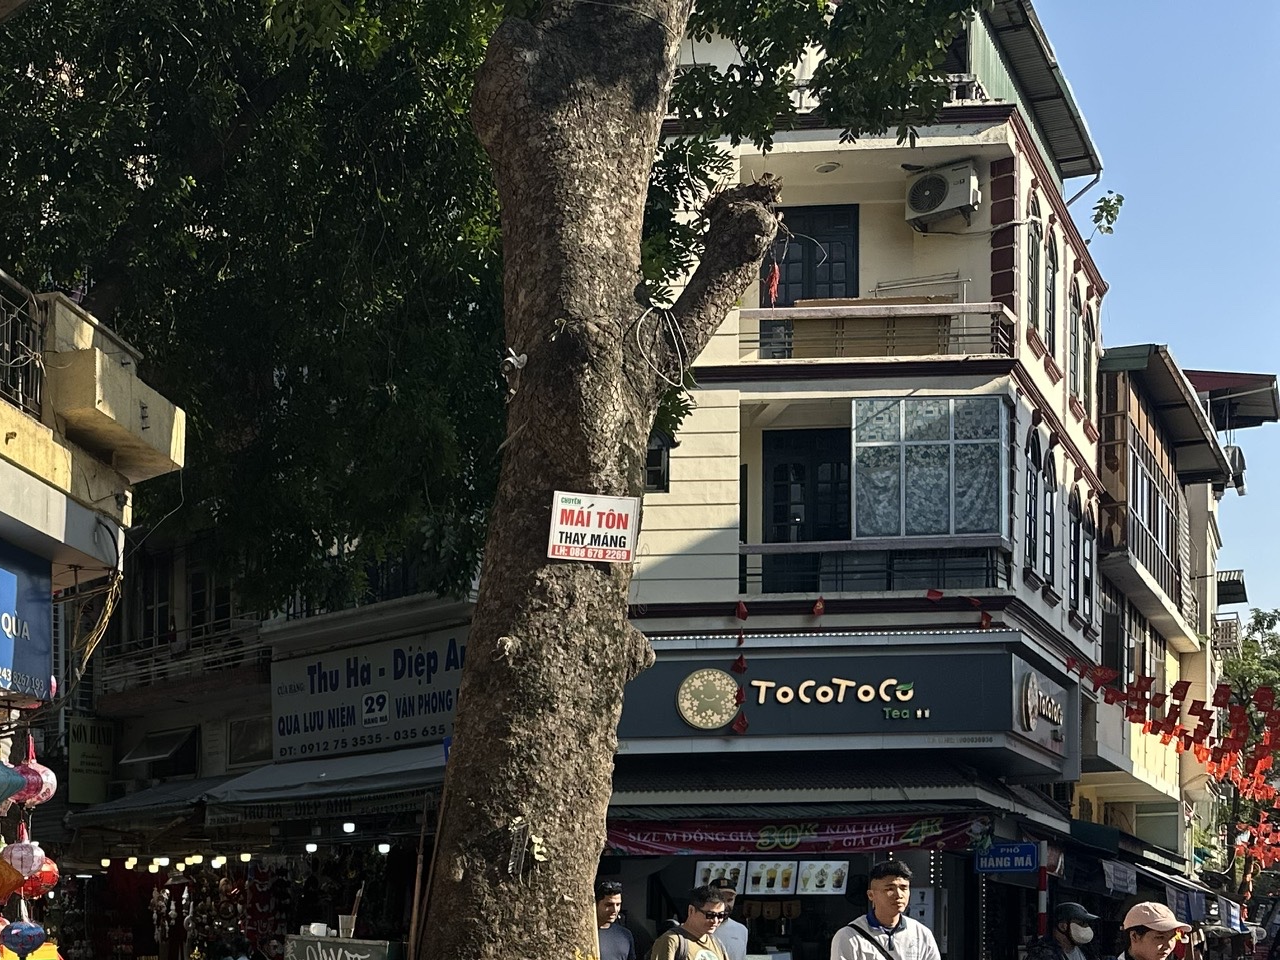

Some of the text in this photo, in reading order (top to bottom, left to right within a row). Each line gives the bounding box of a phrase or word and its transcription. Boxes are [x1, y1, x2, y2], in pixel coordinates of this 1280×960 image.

[560, 506, 629, 530] MÁI TÔN
[559, 531, 627, 548] THAY MÁNG
[554, 545, 627, 560] LH: 088 678 2269
[307, 662, 339, 694] Thu
[346, 656, 370, 688] Hà
[393, 646, 438, 685] Diệp
[12, 671, 30, 687] 8267
[30, 678, 44, 691] 193
[364, 694, 387, 715] 29
[883, 707, 910, 719] Tea
[301, 741, 328, 754] 0912
[334, 738, 347, 749] 75
[352, 734, 382, 747] 3535
[394, 728, 417, 741] 035
[422, 724, 446, 737] 635
[628, 831, 660, 843] SIZE
[664, 831, 678, 843] M
[682, 827, 725, 843] ĐỒNG
[729, 829, 755, 842] GIÁ
[842, 834, 865, 847] GIÁ
[980, 853, 1032, 868] HÀNG MÃ
